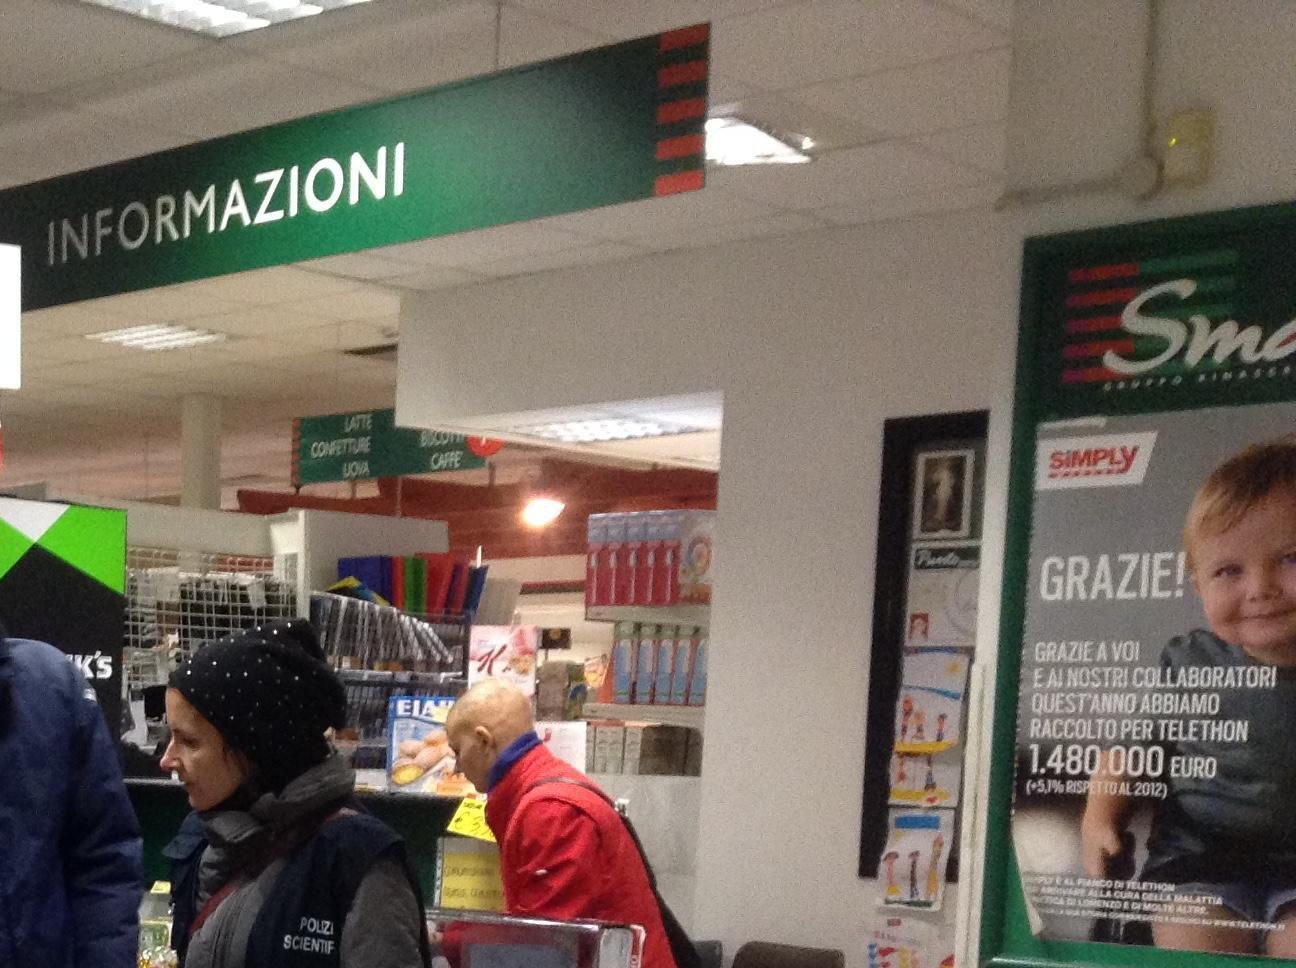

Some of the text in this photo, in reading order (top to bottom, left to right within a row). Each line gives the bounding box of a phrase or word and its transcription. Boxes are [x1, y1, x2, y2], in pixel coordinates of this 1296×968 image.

[47, 141, 405, 266] INFORMAZIONI
[344, 414, 373, 433] LATTE
[310, 435, 371, 459] CONFETTURE
[343, 461, 370, 479] UOVA
[1039, 551, 1185, 602] GRAZIE!
[1034, 640, 1140, 663] GRAZIE A VOI
[66, 650, 112, 679] K'S
[1033, 666, 1277, 689] E AI NOSTRI COLLABORATORI
[1031, 693, 1220, 716] QUEST'ANNO ABBIAMO
[1030, 718, 1249, 743] RACCOLTO PER TELETHON
[1170, 756, 1218, 779] EURO
[1066, 780, 1118, 797] RISPETTO
[1118, 781, 1134, 796] AL
[1135, 781, 1168, 799] 2012)
[283, 934, 335, 954] SCIENTIF
